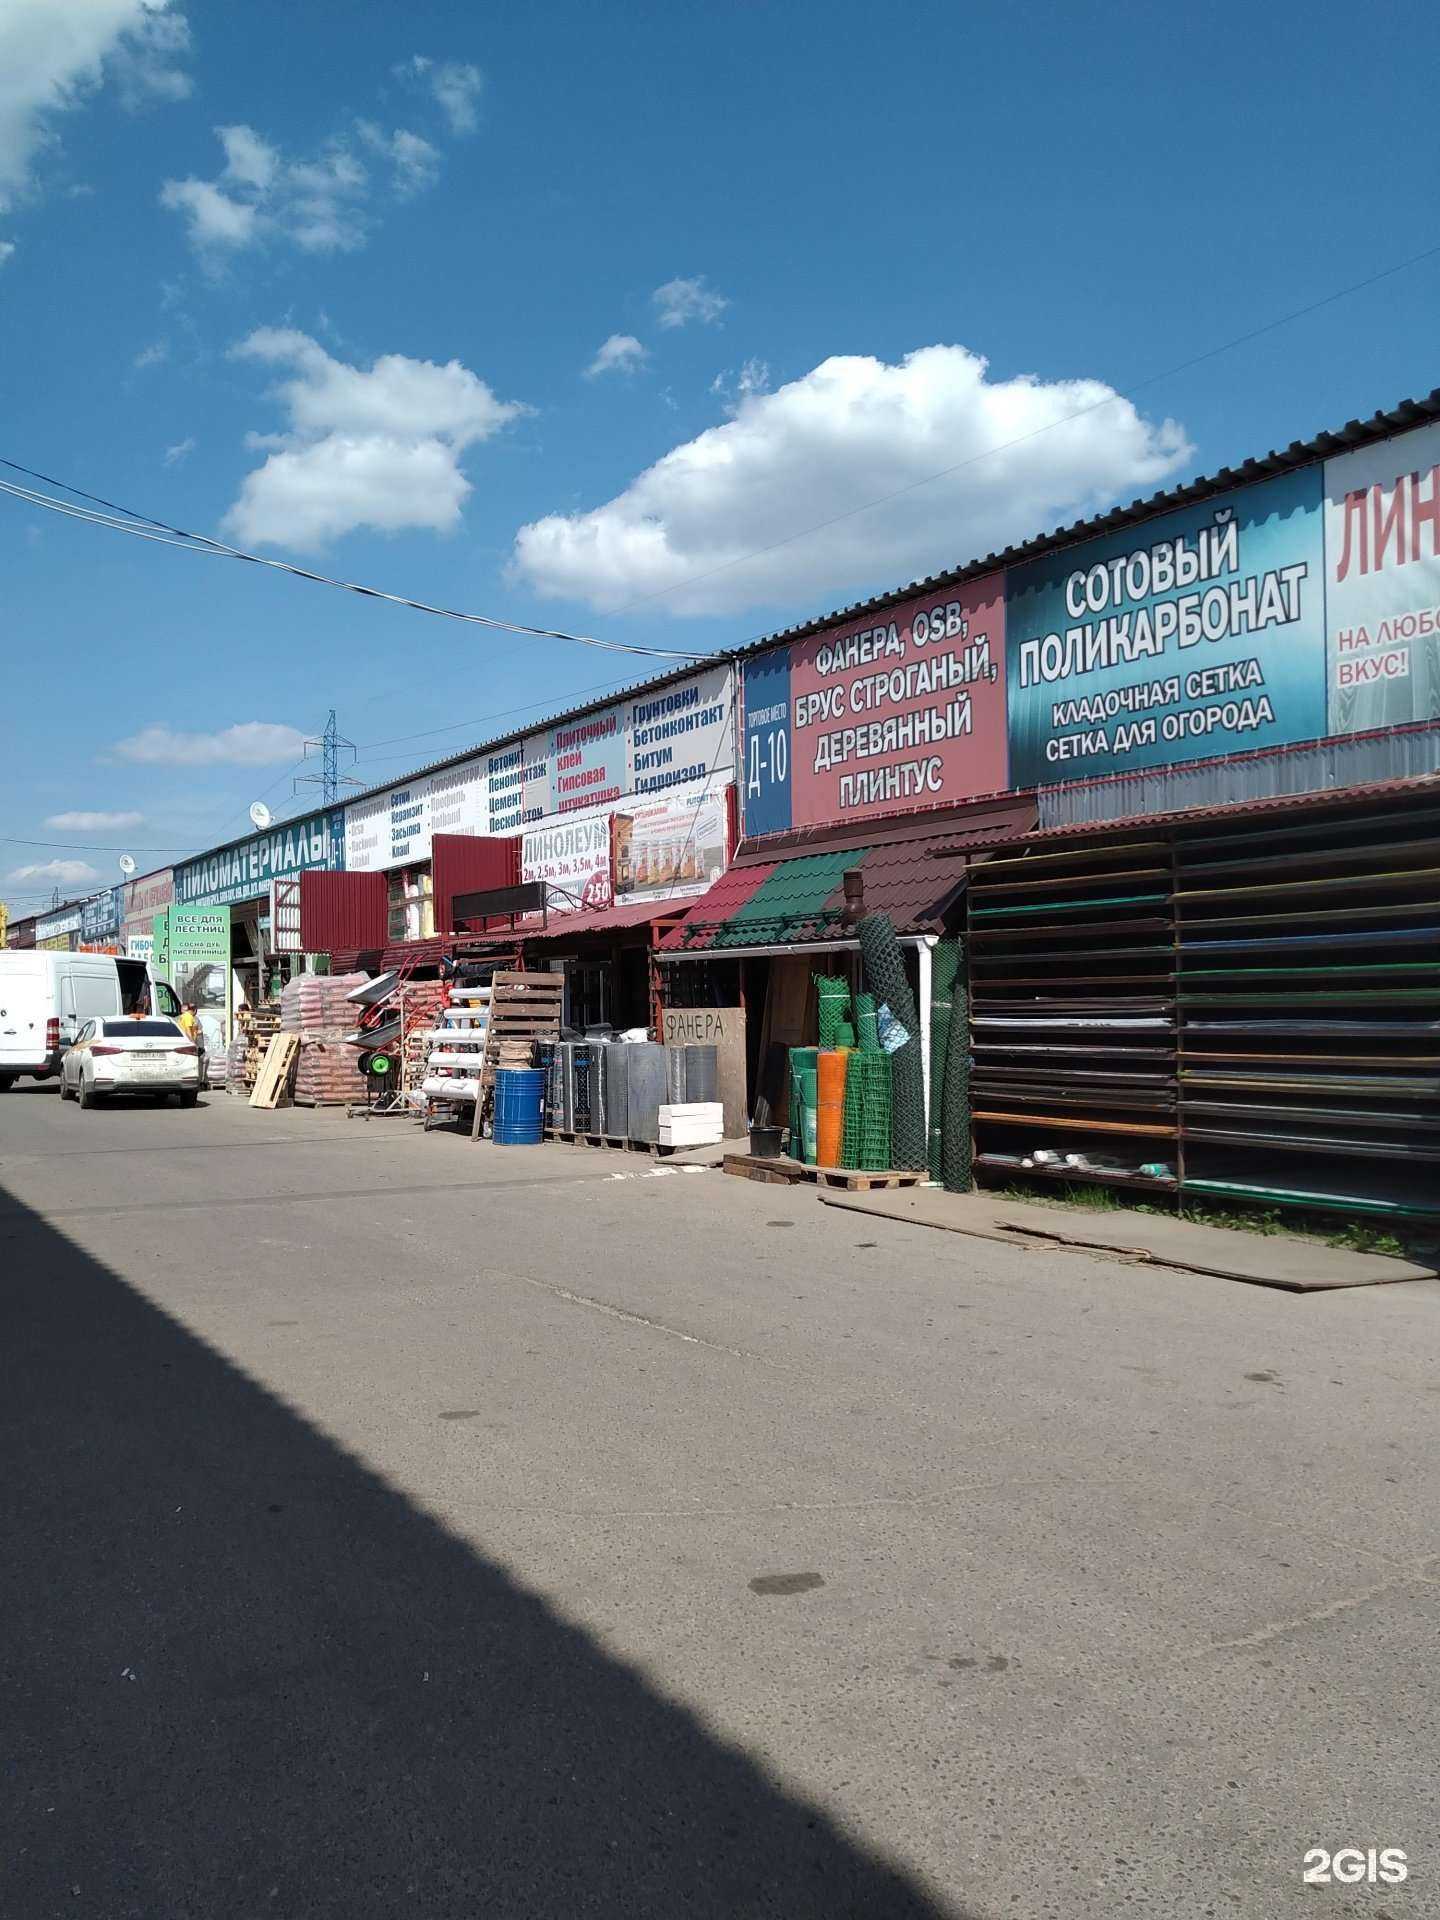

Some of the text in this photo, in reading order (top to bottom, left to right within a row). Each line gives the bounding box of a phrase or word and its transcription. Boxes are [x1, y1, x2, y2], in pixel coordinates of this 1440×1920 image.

[1337, 464, 1440, 583] ЛИН
[1065, 508, 1239, 618] СОТОВЫЙ
[815, 601, 968, 677] ФАНЕРА, OSB,
[1019, 562, 1308, 687] ПОЛИКАРБОНАТ
[1339, 626, 1370, 652] НА
[795, 635, 998, 729] БРУС СТРОГАНЫЙ,
[1340, 652, 1406, 685] ВКУС!
[633, 686, 699, 724] Грунтовки
[1052, 658, 1265, 728] КЛАДОЧНАЯ СЕТКА
[633, 704, 724, 747] Бетонконтакт
[770, 702, 787, 721] МЕСТО
[556, 712, 617, 750] Плиточный
[813, 690, 973, 775] ДЕРЕВЯННЫЙ
[1046, 697, 1276, 762] СЕТКА ДЛЯ ОГОРОДА
[557, 750, 582, 771] клей
[634, 746, 673, 771] Битум
[749, 729, 787, 799] Д-10
[489, 762, 547, 793] Пеномонтаж
[558, 766, 606, 793] Гипсовая
[635, 763, 706, 795] Гидроизол
[839, 755, 943, 808] ПЛИНТУС
[391, 804, 423, 824] Керамзит
[489, 791, 523, 814] Цемент
[558, 786, 620, 814] штукатурка
[392, 822, 421, 841] Засыпка
[489, 807, 543, 832] Пескобетон
[183, 817, 328, 899] ПИЛОМАТЕРИАЛЫ
[524, 822, 608, 864] ЛИНОЛЕУМ
[559, 861, 571, 875] 3м,
[595, 854, 607, 868] 4м
[175, 925, 225, 933] ЛЕСТНИЦ
[177, 915, 223, 924] ВСЕ ДЛЯ
[666, 1013, 724, 1040] ФАНЕРА
